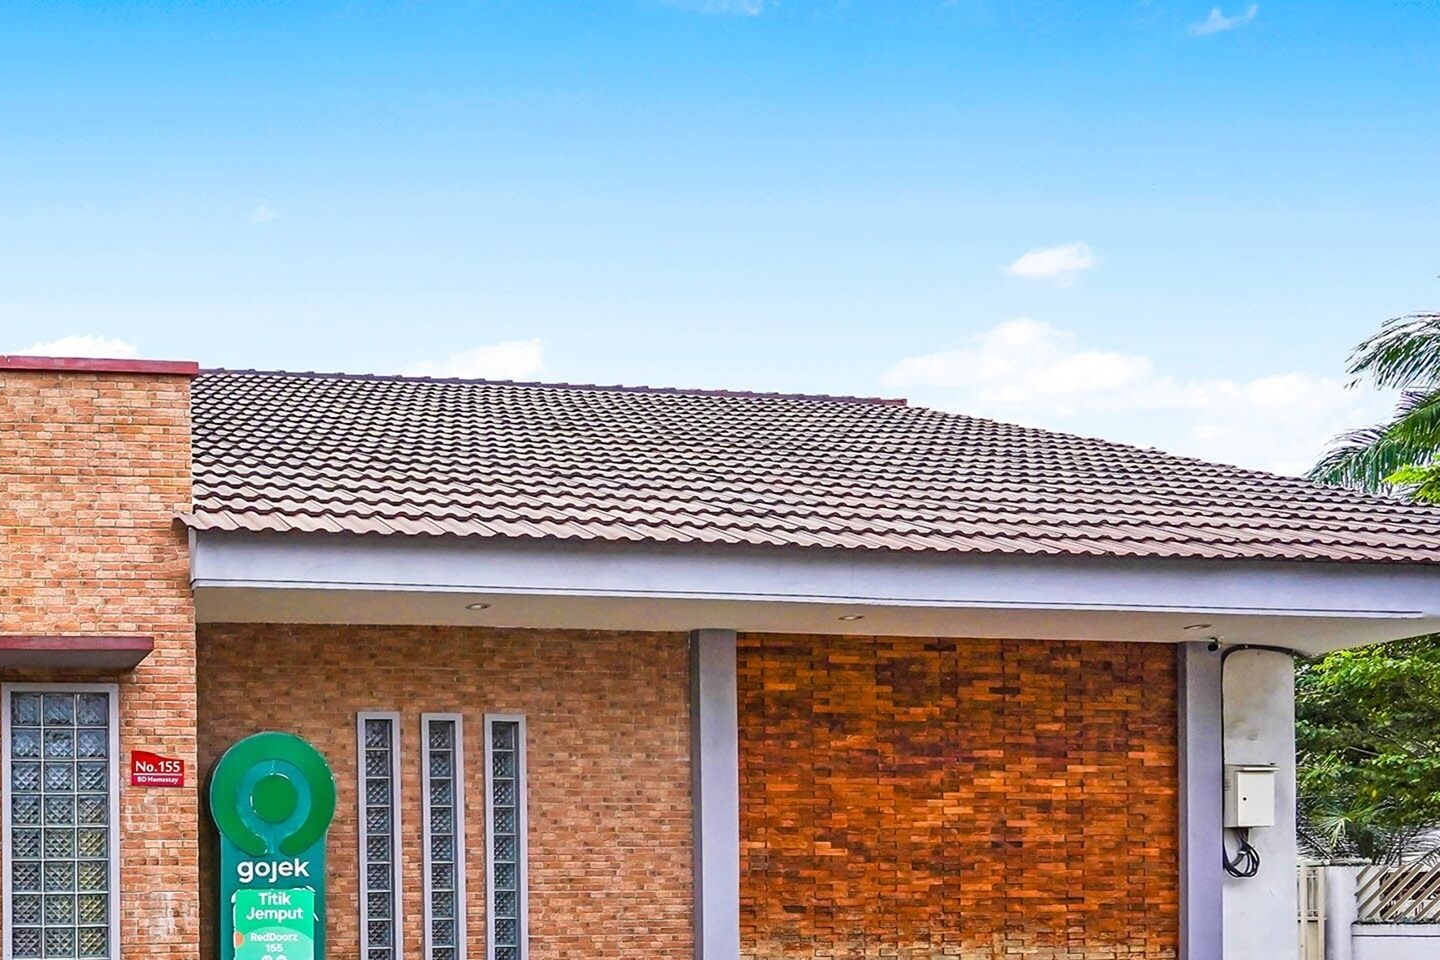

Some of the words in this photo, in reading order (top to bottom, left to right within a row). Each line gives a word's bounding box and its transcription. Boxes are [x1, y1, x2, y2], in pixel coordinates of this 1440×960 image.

[237, 858, 310, 883] gojek
[258, 891, 292, 906] Titik
[246, 906, 304, 923] Jemput
[250, 932, 299, 942] RedDoorz
[265, 943, 284, 953] 155
